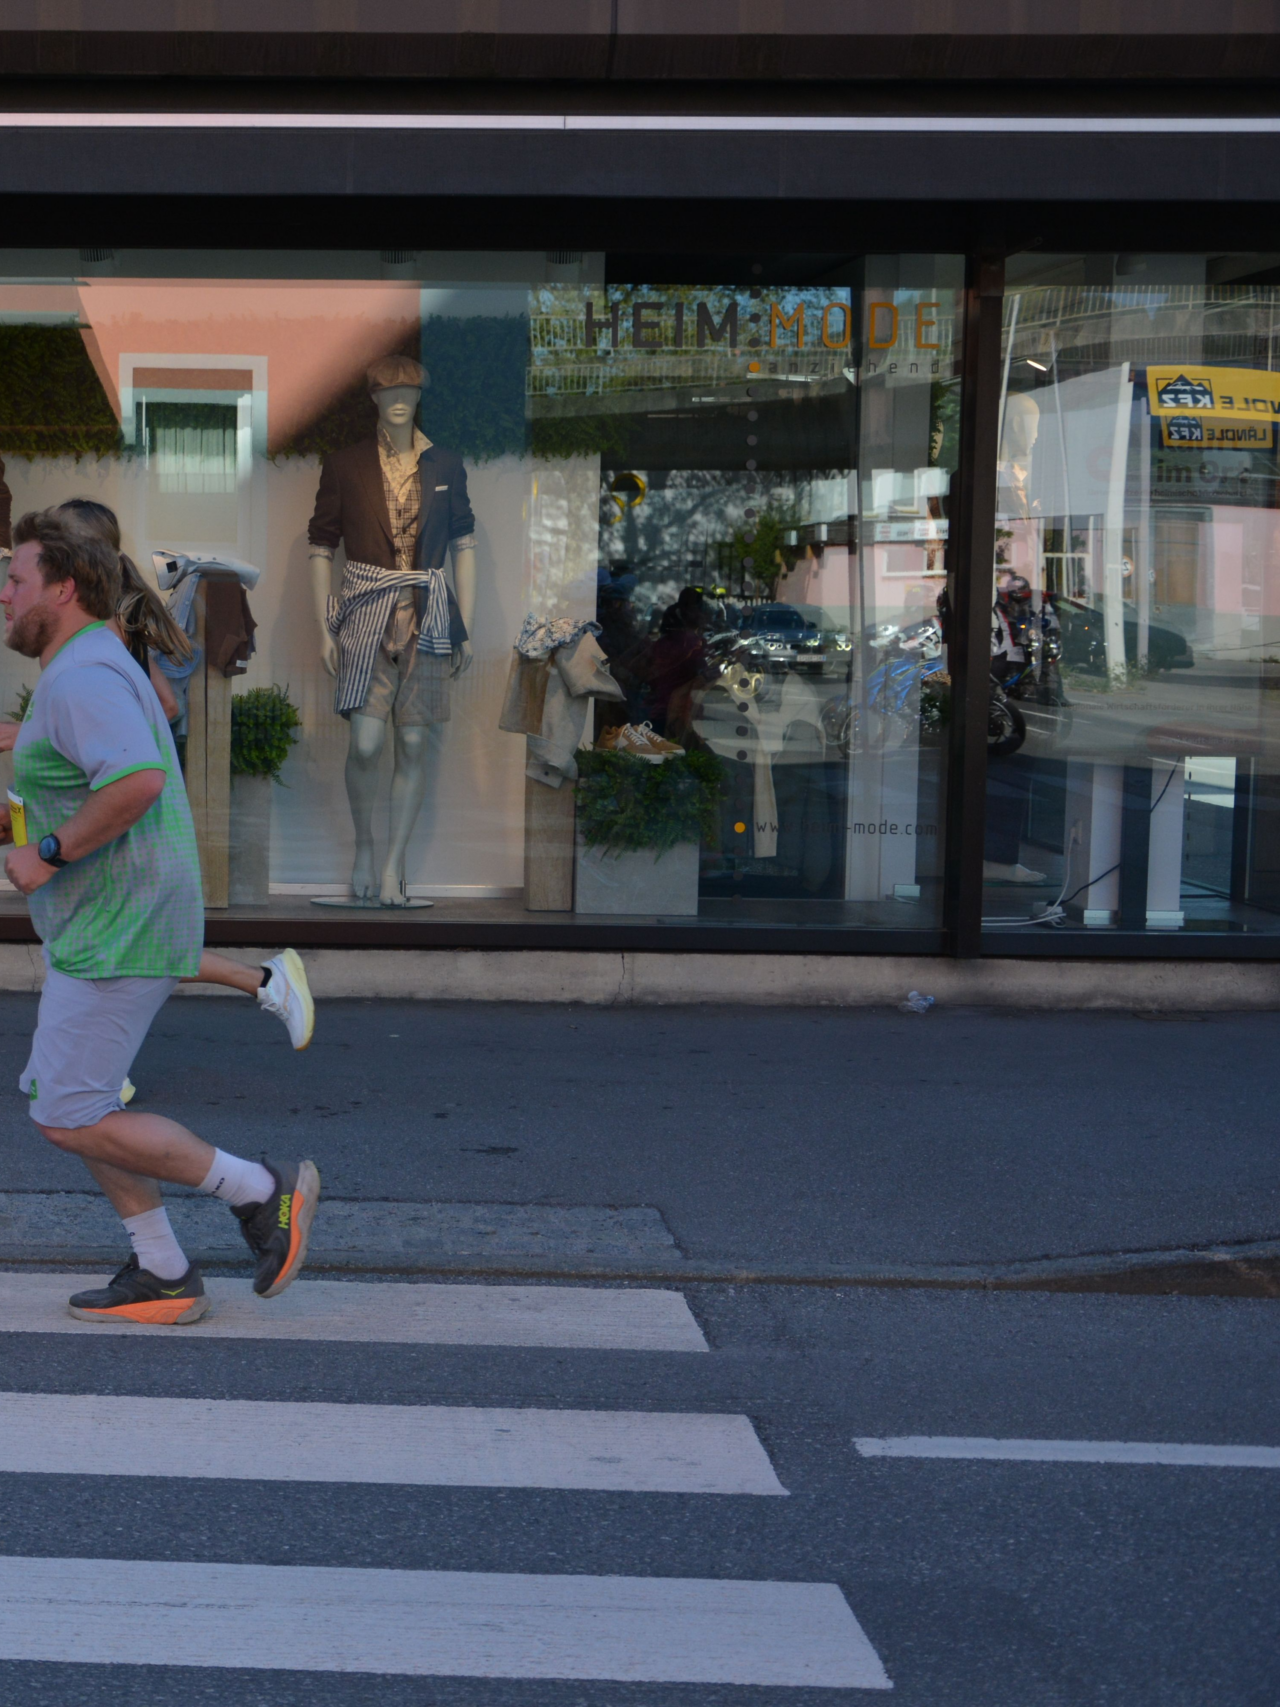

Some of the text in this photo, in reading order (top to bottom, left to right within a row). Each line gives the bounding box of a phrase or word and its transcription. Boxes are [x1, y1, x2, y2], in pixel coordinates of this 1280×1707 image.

[585, 301, 941, 349] HEIM MODE
[768, 358, 940, 374] anziehend
[1156, 459, 1192, 483] im
[278, 1195, 291, 1229] HOKA
